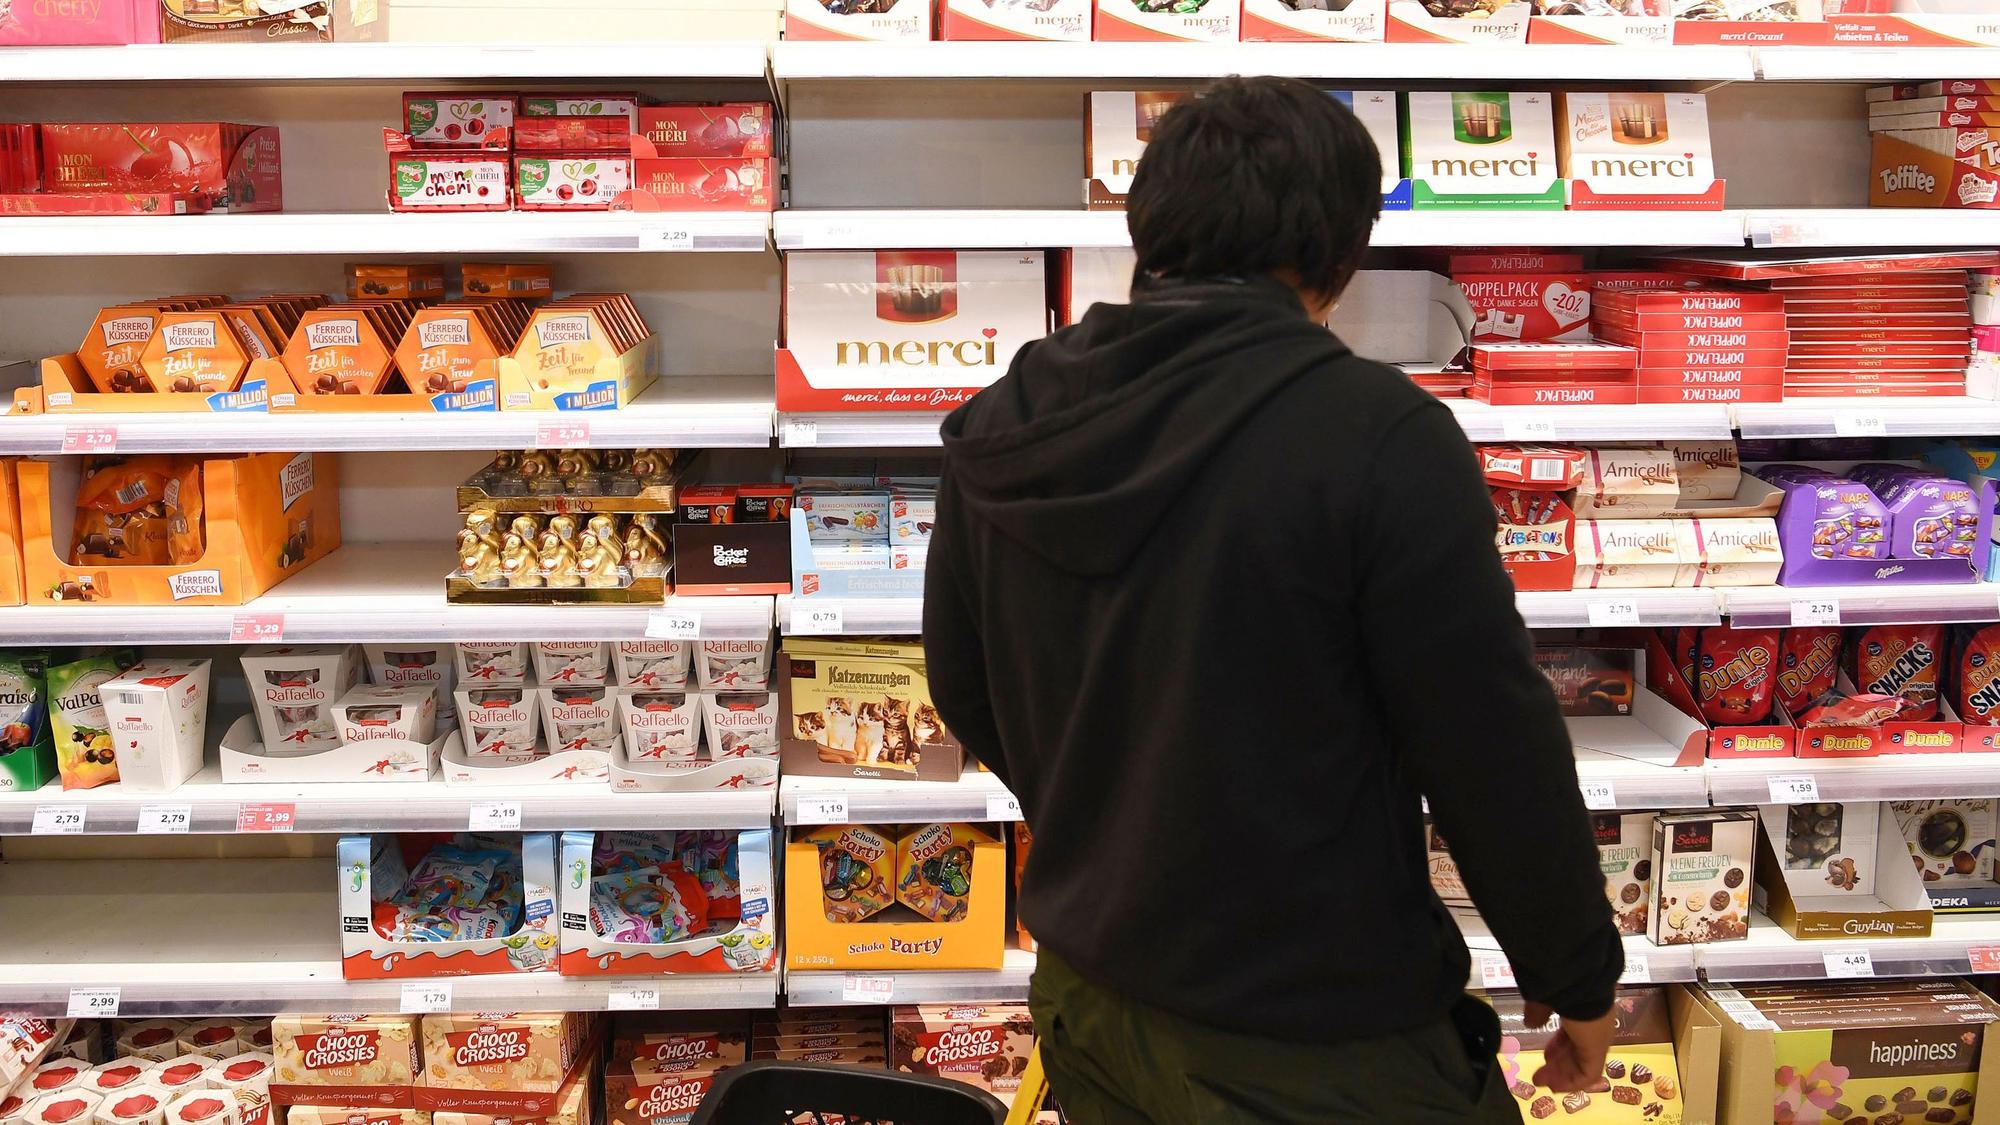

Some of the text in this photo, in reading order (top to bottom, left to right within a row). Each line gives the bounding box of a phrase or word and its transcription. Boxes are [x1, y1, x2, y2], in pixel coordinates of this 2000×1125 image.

[266, 22, 309, 38] Classic
[1833, 23, 1859, 32] Vielfalt
[1746, 31, 1785, 42] Crocant
[1833, 32, 1909, 42] Anbieten & Teilen
[655, 120, 678, 129] MON
[63, 154, 93, 167] MON
[1432, 152, 1537, 177] merci
[1591, 152, 1694, 177] merci
[652, 172, 676, 182] MON
[1879, 164, 1936, 194] Toffifee
[425, 180, 472, 197] chéri
[662, 231, 688, 241] 2,29
[1491, 257, 1544, 269] DOPPELPACK
[1461, 281, 1539, 297] DOPPELPACK
[1482, 297, 1539, 307] 2X DANKE SAGEN
[1552, 293, 1584, 313] -20%
[1682, 297, 1741, 310] DOPPELPACK
[111, 320, 149, 333] FERRERO
[427, 322, 463, 334] FERRERO
[545, 320, 583, 332] FERRERO
[1684, 316, 1742, 328] DOPPELPACK
[108, 329, 151, 343] KÜSSCHEN
[171, 325, 210, 338] FERRERO
[314, 323, 354, 336] FERRERO
[168, 335, 213, 349] KÜSSCHEN
[311, 333, 356, 347] KÜSSCHEN
[423, 331, 466, 344] KÜSSCHEN
[542, 330, 586, 343] KÜSSCHEN
[1687, 334, 1746, 347] DOPPELPACK
[836, 328, 998, 368] merci
[102, 345, 134, 369] Zeit
[163, 351, 212, 376] Zeit für
[306, 349, 338, 375] Zeit
[417, 348, 471, 372] Zeit zum
[536, 346, 585, 370] Zeit für
[1686, 352, 1744, 365] DOPPELPACK
[194, 369, 228, 383] Freunde
[336, 367, 375, 379] Küsschen
[1682, 370, 1741, 383] DOPPELPACK
[219, 396, 226, 409] 1
[228, 388, 268, 408] MILLION
[444, 397, 451, 409] 1
[451, 389, 493, 408] MILLION
[566, 388, 615, 409] 1 MILLION
[842, 388, 964, 406] merci, dass es Dich
[1535, 389, 1595, 402] DOPPELPACK
[1682, 388, 1741, 401] DOPPELPACK
[1525, 423, 1549, 432] 4,99
[1855, 418, 1879, 427] 9,99
[86, 433, 113, 445] 2,79
[559, 428, 585, 439] 2,79
[1673, 446, 1734, 463] Amicelli
[1974, 456, 1991, 464] NEW
[286, 456, 312, 479] FERRERO
[1603, 461, 1671, 478] Amicelli
[284, 474, 313, 500] KÜSSCHEN
[1817, 487, 1870, 504] Milka NAPS
[1943, 490, 1970, 501] NAPS
[1603, 531, 1669, 548] Amicelli
[1706, 529, 1772, 547] Amicelli
[712, 545, 749, 559] Pocket
[712, 555, 747, 566] Coffee
[1874, 564, 1905, 580] Milka
[177, 574, 215, 586] FERRERO
[174, 583, 219, 596] KÜSSCHEN
[1609, 605, 1632, 615] 2,79
[1811, 605, 1834, 615] 2,79
[670, 618, 695, 630] 3,29
[812, 613, 837, 623] 0,79
[253, 623, 280, 634] 3,29
[620, 640, 679, 654] Raffaello
[703, 640, 764, 653] Raffaello
[1865, 639, 1907, 676] Dumle
[1777, 632, 1841, 698] Dumle
[1867, 641, 1935, 697] SNACKS
[385, 669, 442, 682] Raffaello
[828, 666, 911, 688] Katzenzungen
[1699, 646, 1771, 700] Dumle
[1743, 671, 1769, 690] original
[1908, 682, 1935, 690] original
[266, 688, 326, 702] Raffaello
[468, 710, 528, 724] Raffaello
[552, 706, 610, 721] Raffaello
[630, 713, 690, 727] Raffaello
[714, 712, 774, 726] Raffaello
[117, 721, 153, 732] Raffaello
[345, 727, 407, 741] Raffaello
[1904, 730, 1954, 747] Dumle
[1734, 734, 1785, 752] Dumle
[1822, 734, 1873, 750] Dumle
[852, 767, 882, 777] Sarotti
[1586, 788, 1609, 797] 1,19
[1789, 783, 1812, 793] 1,59
[819, 804, 844, 814] 1,19
[55, 814, 80, 825] 2,79
[161, 814, 185, 825] 2,79
[264, 812, 290, 824] 2,99
[850, 828, 881, 848] Schoko
[912, 824, 942, 848] Schoko
[1675, 834, 1711, 846] Sarotti
[836, 831, 886, 863] Party
[908, 826, 954, 863] Party
[1607, 846, 1641, 862] FREUDEN
[1669, 854, 1733, 870] KLEINE FREUDEN
[1927, 897, 1970, 906] EDEKA
[848, 935, 944, 957] Schoko Party
[794, 955, 805, 964] 12
[812, 954, 829, 965] 250
[1844, 955, 1866, 966] 4,49
[424, 993, 447, 1003] 1,79
[630, 990, 654, 1000] 1,79
[90, 997, 115, 1008] 2,99
[315, 1034, 368, 1051] CHOCO
[466, 1032, 518, 1049] CHOCO
[938, 1030, 993, 1050] CHOCO
[455, 1043, 526, 1066] CROSSIES
[656, 1040, 707, 1061] CHOCO
[926, 1040, 1000, 1065] CROSSIES
[1869, 1037, 1959, 1067] happiness
[304, 1046, 376, 1069] CROSSIES
[327, 1066, 353, 1078] Weiß
[478, 1063, 504, 1075] Weiß
[942, 1062, 981, 1074] Zartbitter
[649, 1081, 703, 1103] CHOCO
[291, 1094, 316, 1104] Voller
[437, 1099, 461, 1108] Voller
[655, 1115, 692, 1125] Original
